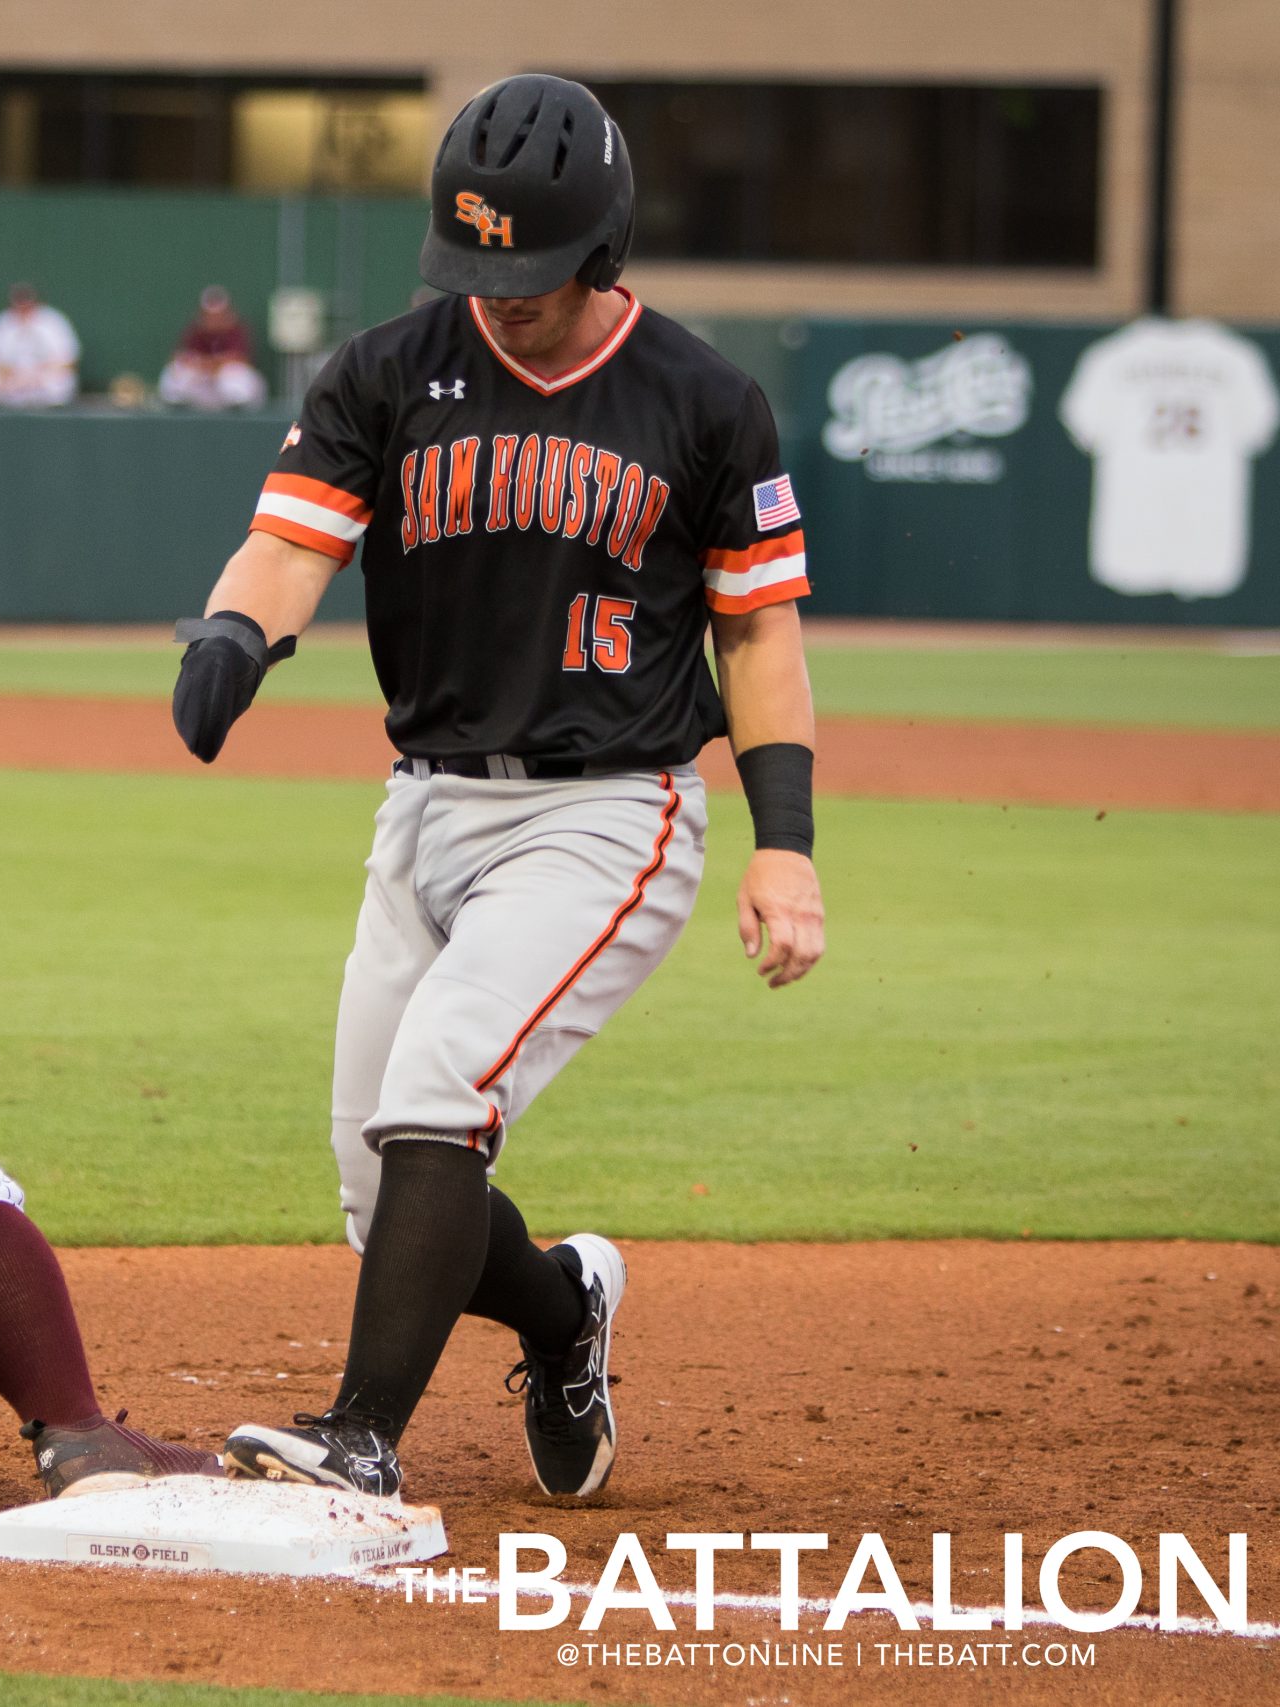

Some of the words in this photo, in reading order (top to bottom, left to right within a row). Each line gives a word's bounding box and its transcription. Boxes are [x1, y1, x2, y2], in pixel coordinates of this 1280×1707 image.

[401, 437, 480, 556] SAM
[486, 434, 670, 571] HOUSTON
[562, 593, 637, 673] 15
[90, 1544, 129, 1557] OLSEN
[152, 1548, 189, 1562] FIELD
[361, 1547, 385, 1563] TEXAS
